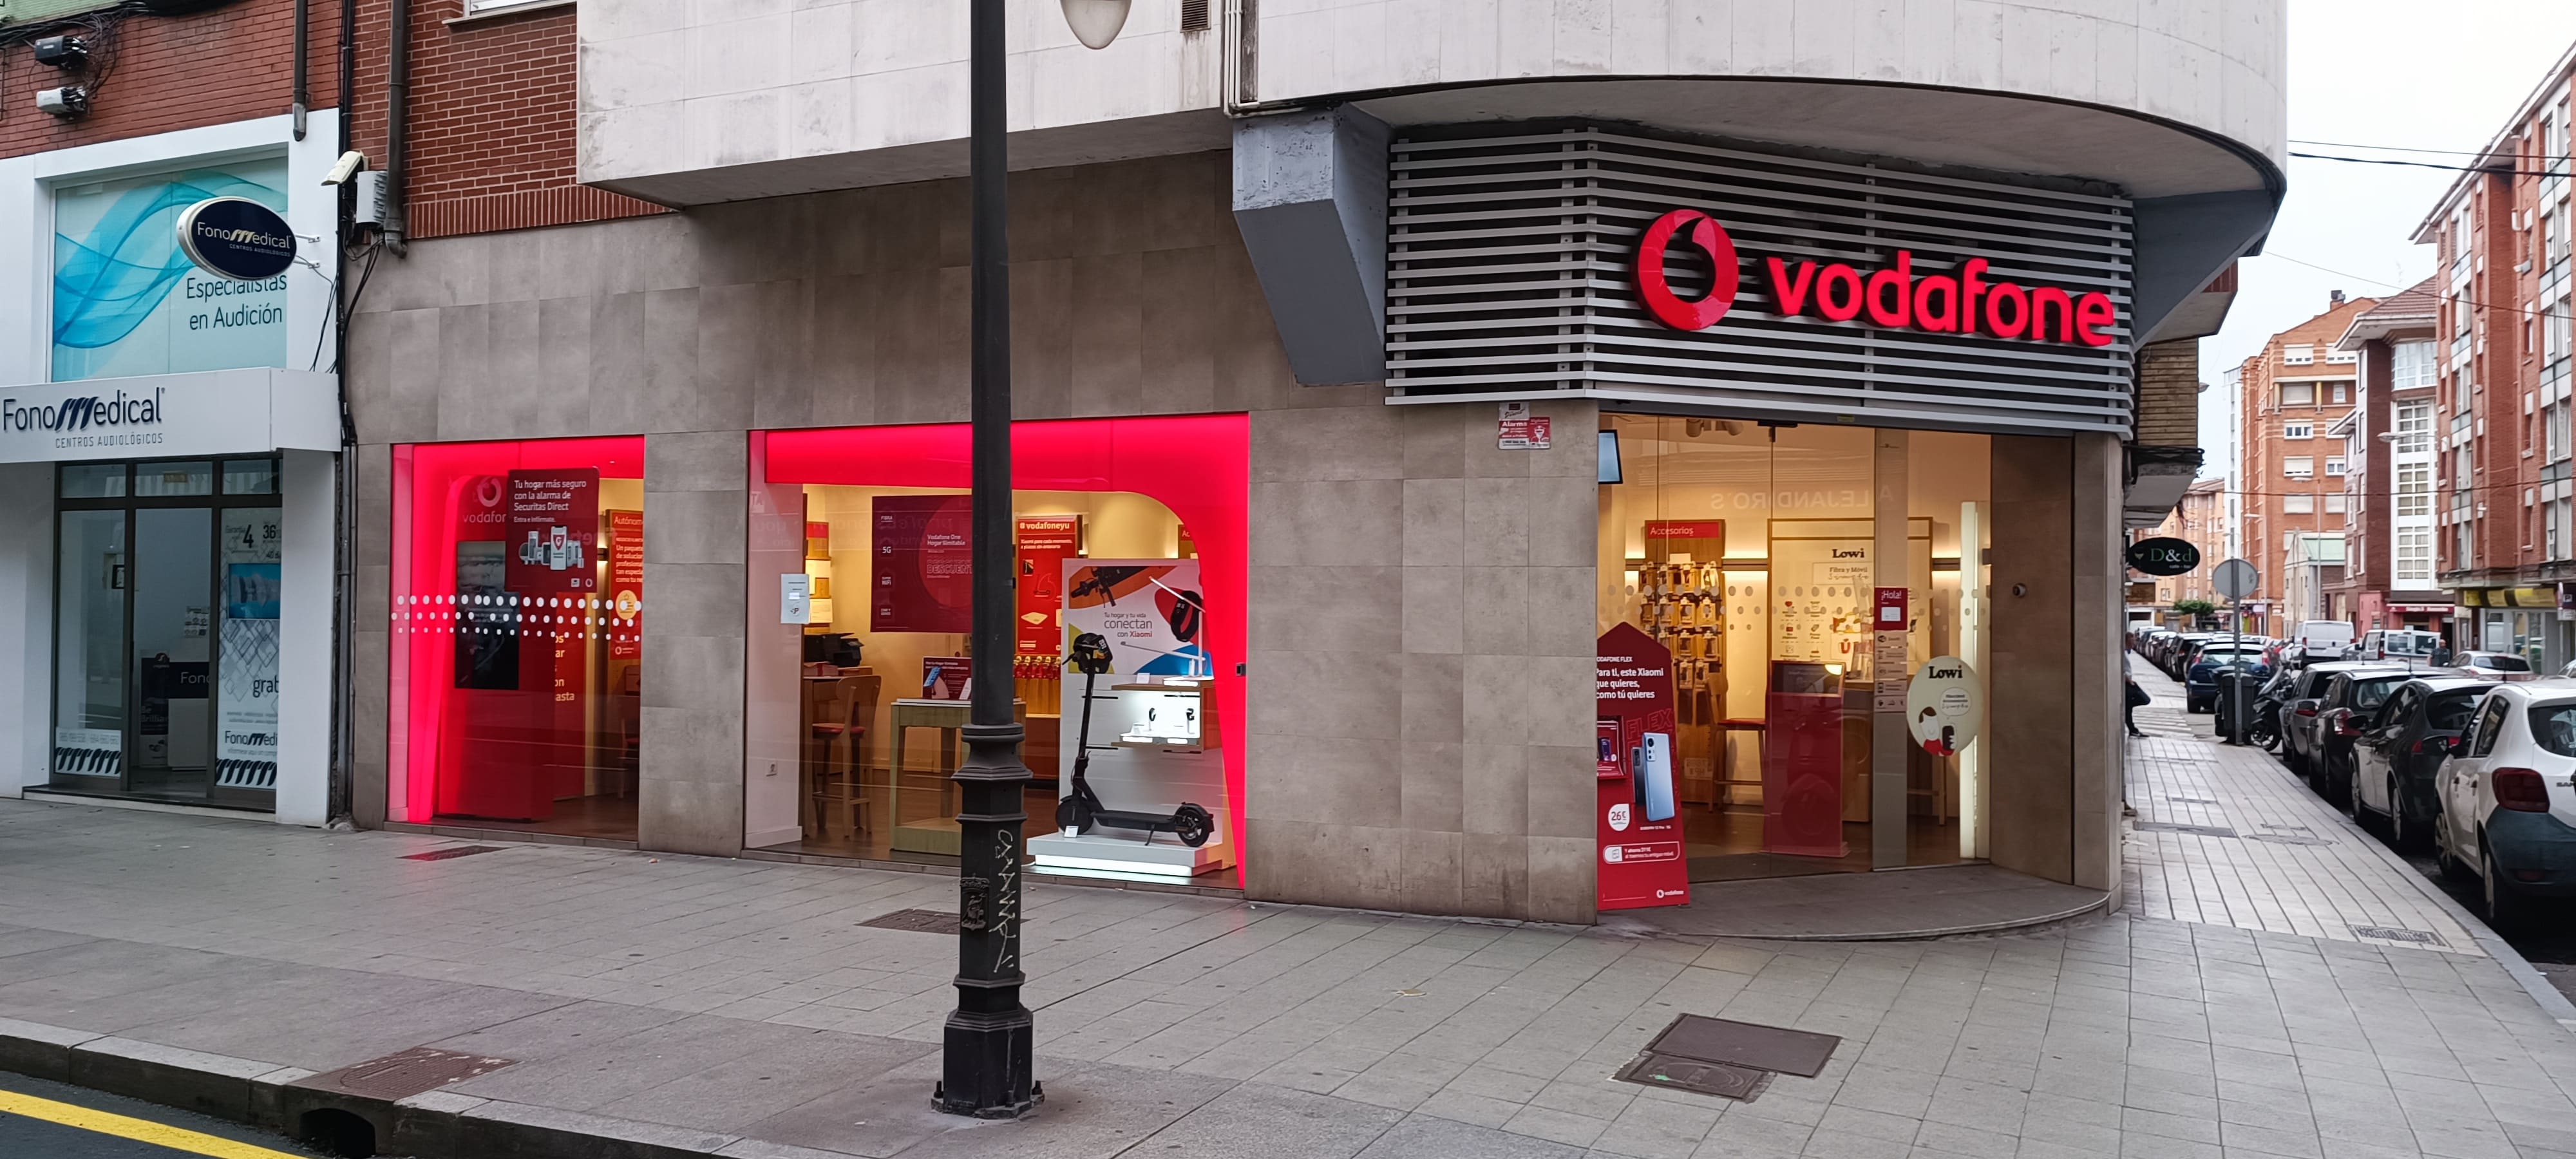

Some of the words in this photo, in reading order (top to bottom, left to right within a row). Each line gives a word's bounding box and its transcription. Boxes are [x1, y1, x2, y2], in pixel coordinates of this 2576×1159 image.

[229, 243, 252, 252] CENTROS
[187, 274, 287, 303] Especialistas
[1766, 250, 2114, 347] vodafone
[189, 314, 208, 330] en
[213, 302, 282, 328] Audición
[55, 436, 94, 449] CENTROS
[97, 432, 163, 446] AUDIOLÓGICOS
[524, 480, 544, 490] hogar
[545, 479, 561, 488] más
[562, 481, 587, 490] seguro
[528, 491, 535, 500] la
[562, 491, 571, 499] de
[514, 502, 546, 511] Securitas
[547, 502, 569, 511] Direct
[1026, 522, 1070, 531] vodafoneyu
[1650, 526, 1694, 535] Accesorios
[243, 524, 254, 549] 4
[263, 525, 276, 539] 36
[1832, 548, 1865, 558] Lowi
[2150, 548, 2192, 561] D&d
[1881, 590, 1902, 600] ¡Hola!
[1104, 619, 1152, 629] conectan
[1638, 668, 1663, 676] Xiaomi
[1929, 664, 1963, 679] Lowi
[1611, 679, 1640, 689] quieres,
[1617, 690, 1625, 699] tú
[1627, 690, 1655, 700] quieres
